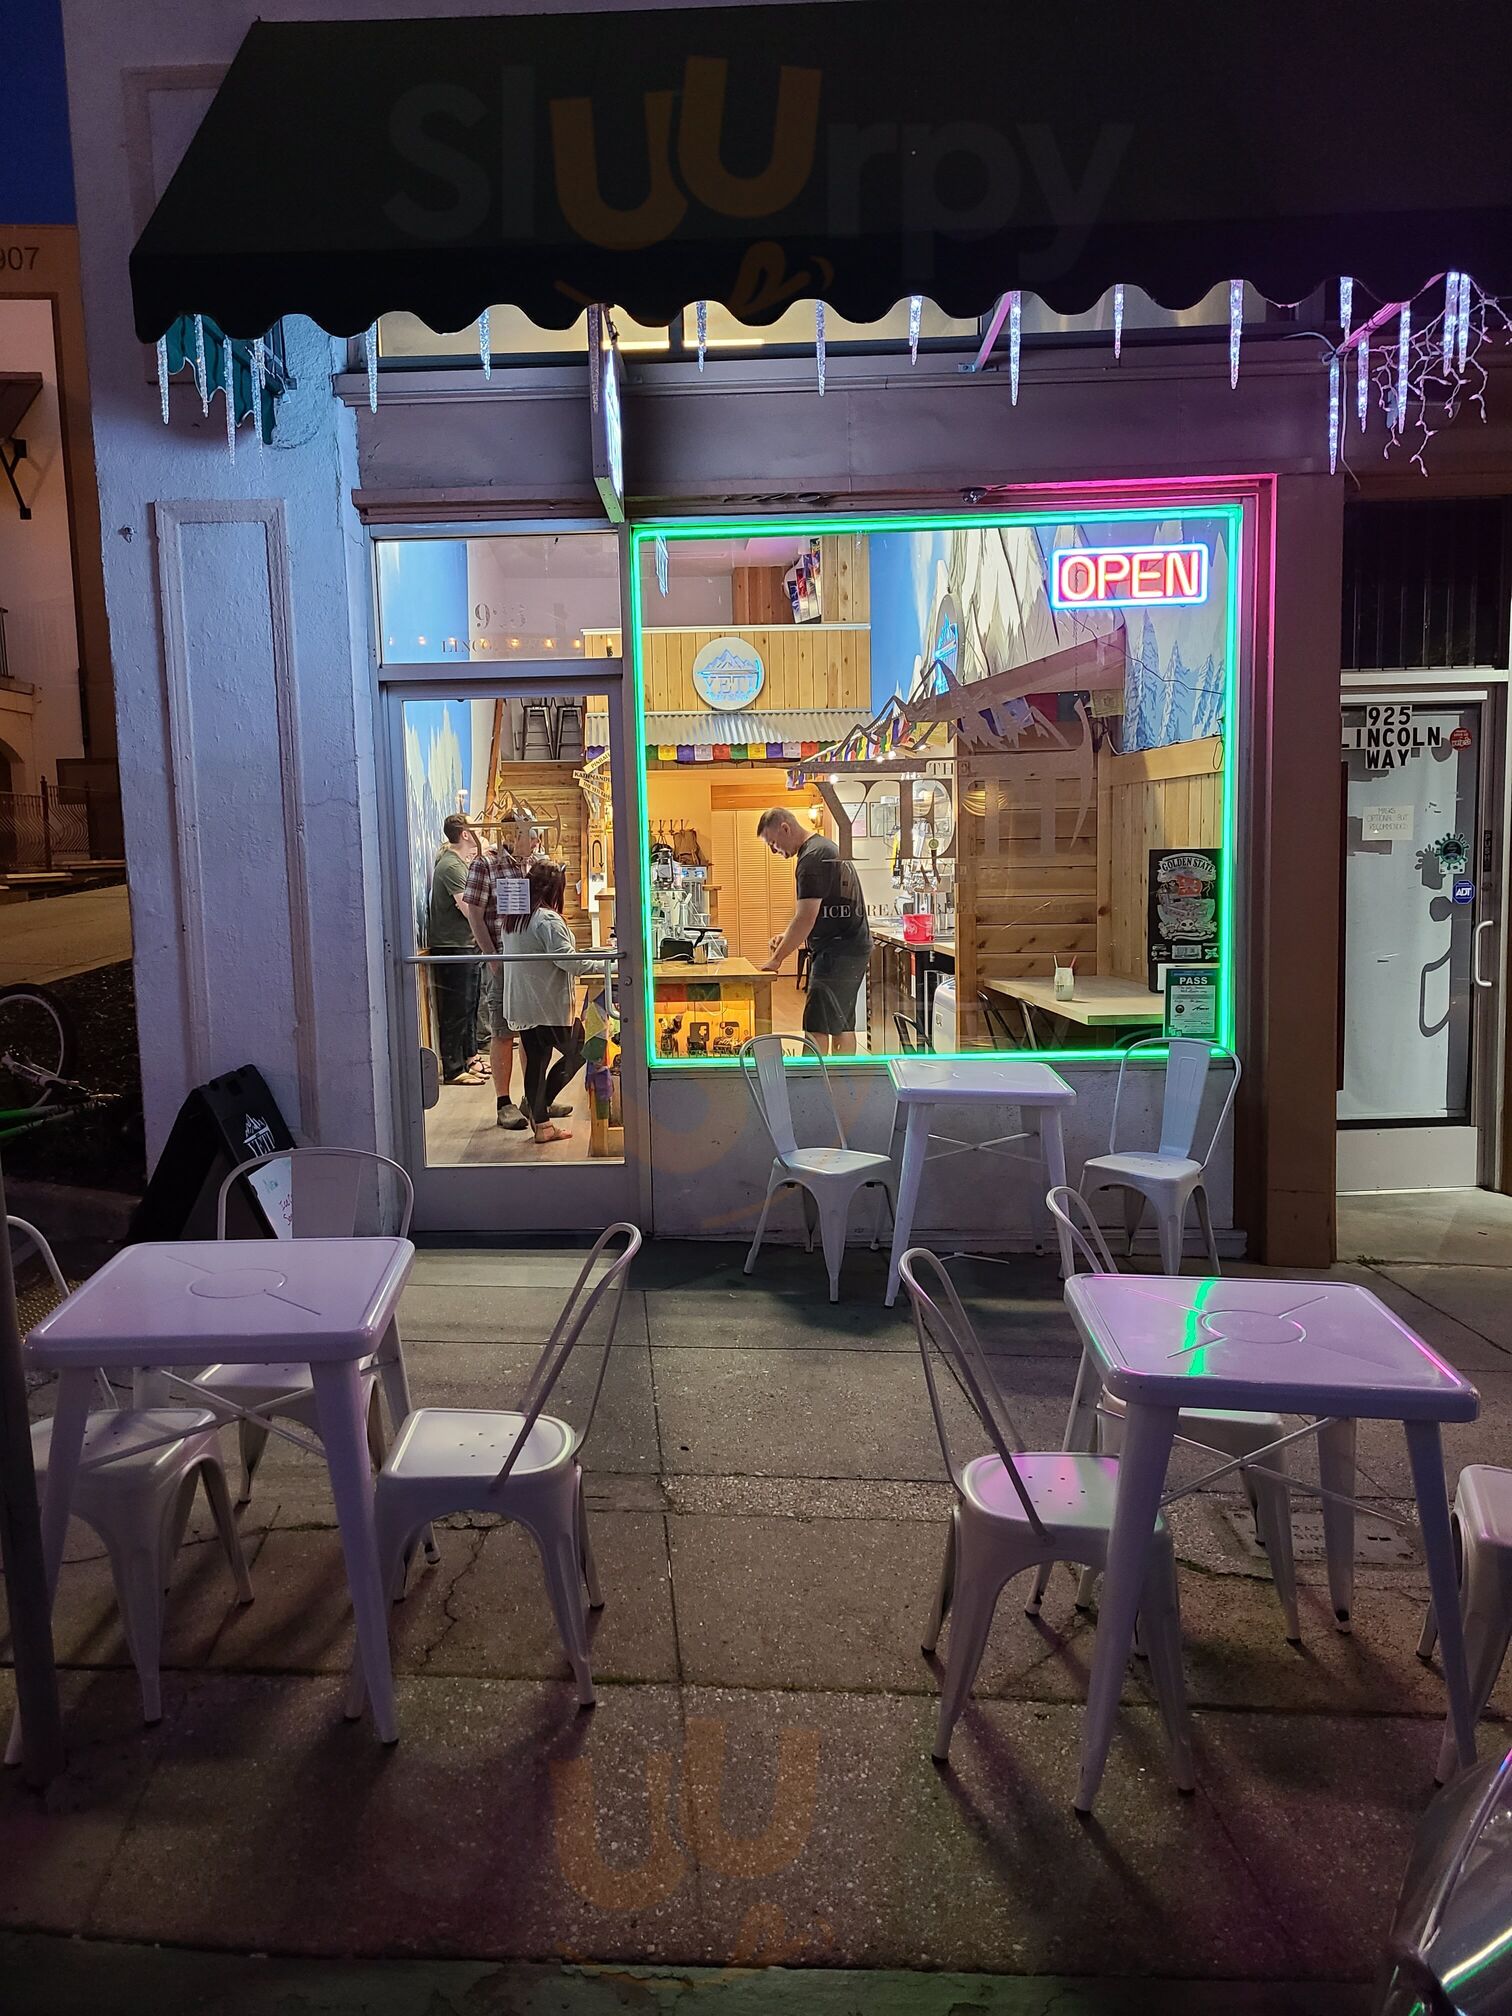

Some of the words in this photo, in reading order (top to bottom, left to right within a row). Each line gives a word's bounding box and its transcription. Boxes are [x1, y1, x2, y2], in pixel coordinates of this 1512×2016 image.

[1061, 551, 1201, 601] OPEN
[1368, 706, 1411, 726] 925
[1366, 749, 1410, 769] WAY
[1162, 857, 1193, 872] GOLDEN
[1193, 858, 1215, 873] STATE
[1456, 887, 1472, 897] ADT
[822, 904, 851, 919] ICE
[1179, 976, 1208, 985] PASS
